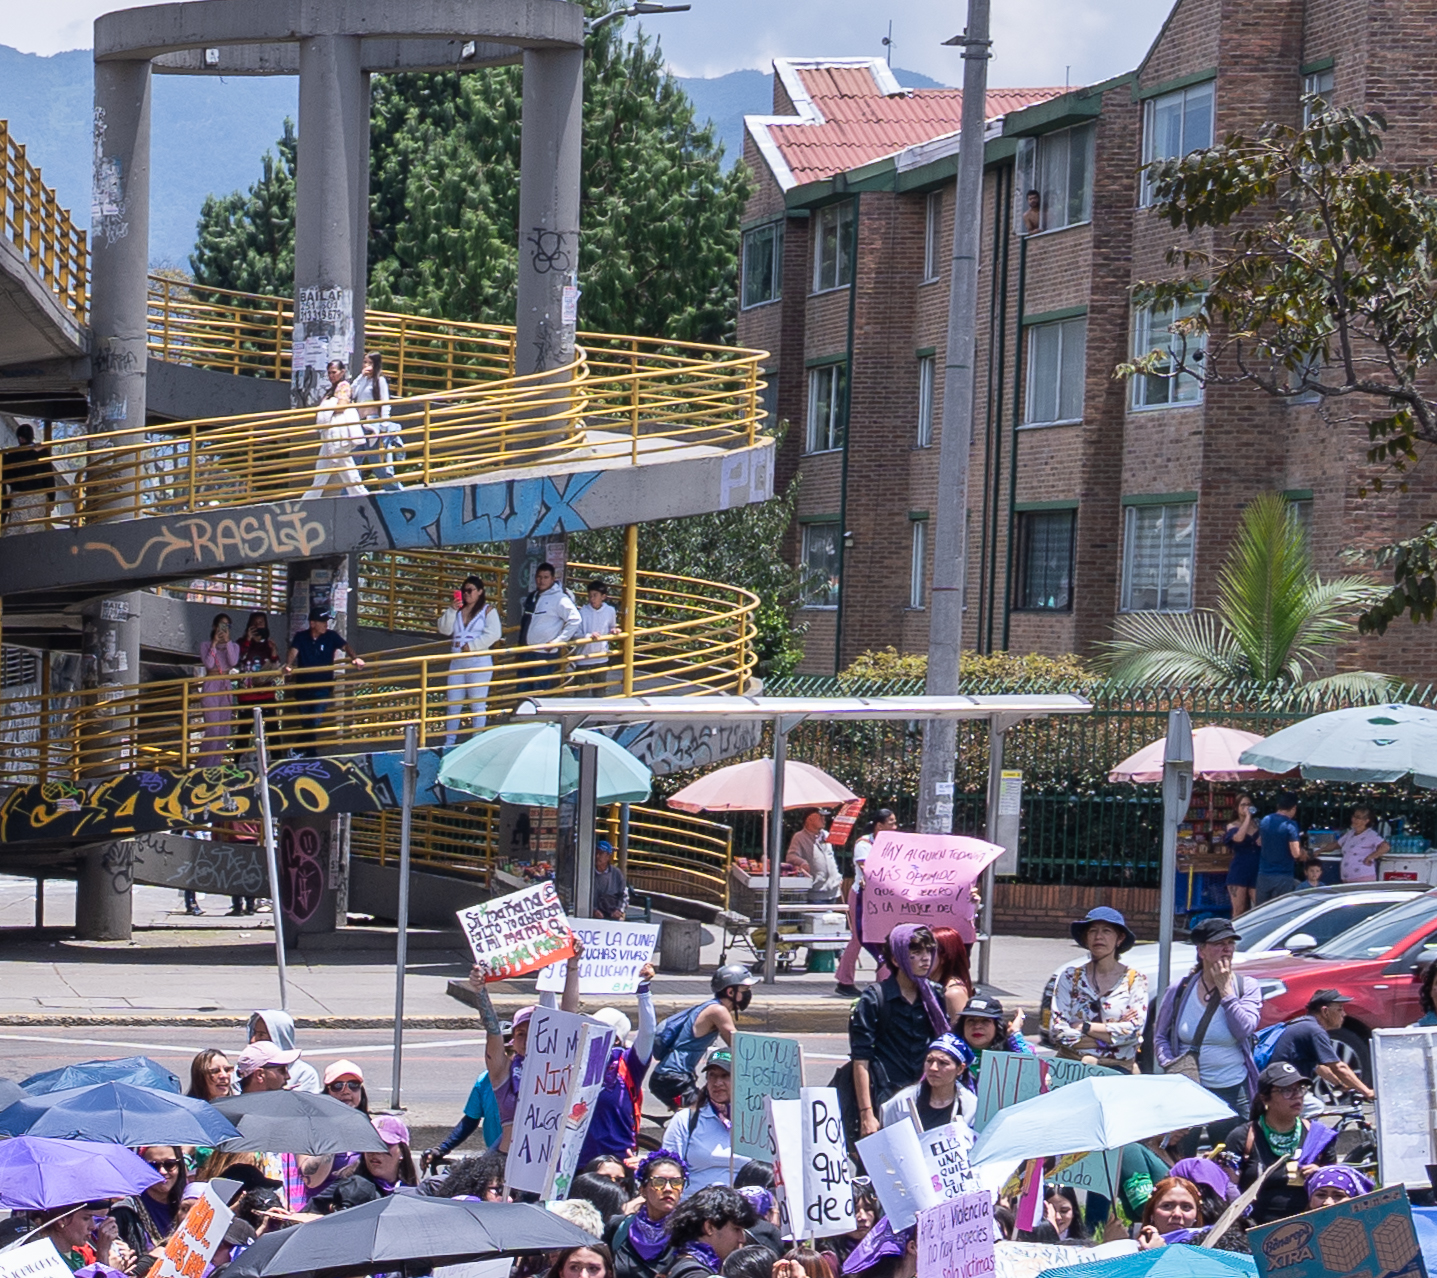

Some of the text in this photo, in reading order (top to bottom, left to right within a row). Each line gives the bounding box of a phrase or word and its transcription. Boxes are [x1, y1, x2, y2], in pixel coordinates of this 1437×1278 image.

[867, 864, 902, 882] MÁS
[873, 886, 896, 898] QUE
[882, 900, 894, 914] LA
[936, 902, 956, 916] DEL
[604, 930, 622, 949] LA
[625, 929, 657, 949] CUNA
[619, 948, 650, 963] VIVAS
[1266, 1245, 1316, 1273] XTRA
